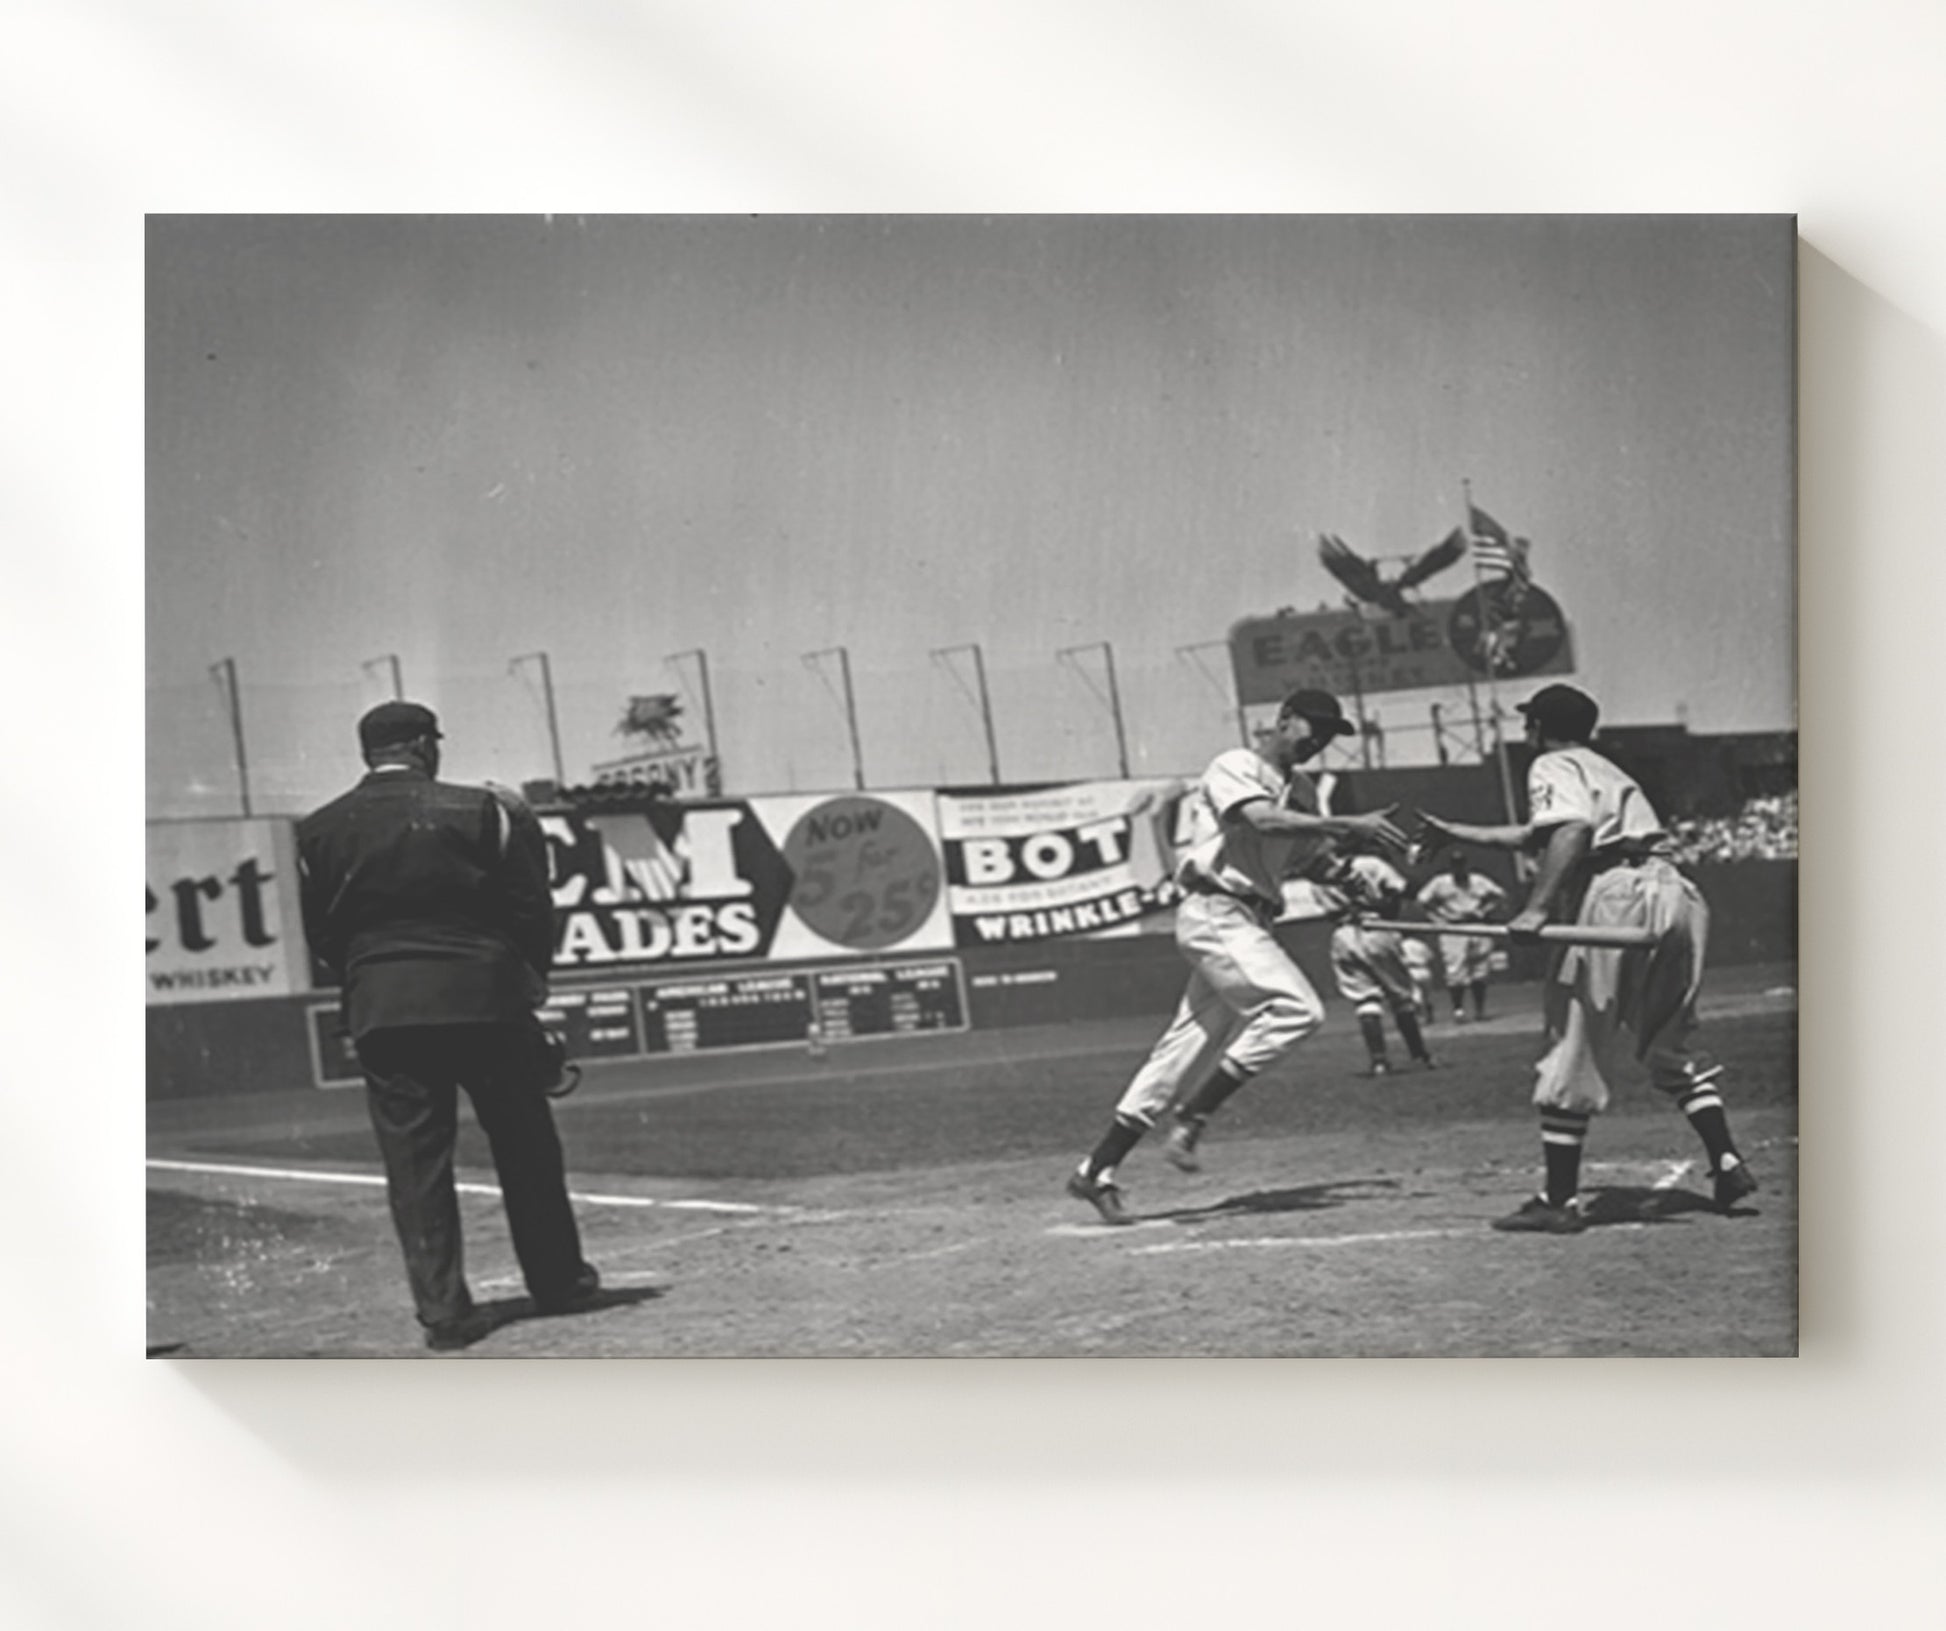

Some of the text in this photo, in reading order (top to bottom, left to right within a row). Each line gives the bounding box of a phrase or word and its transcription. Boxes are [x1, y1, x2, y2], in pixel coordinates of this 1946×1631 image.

[1253, 622, 1441, 667] EAGLE
[805, 808, 883, 847] NOW
[961, 816, 1127, 885] BOT
[797, 851, 836, 907] 5
[551, 901, 762, 966] ADES
[148, 962, 277, 990] WHISKEY
